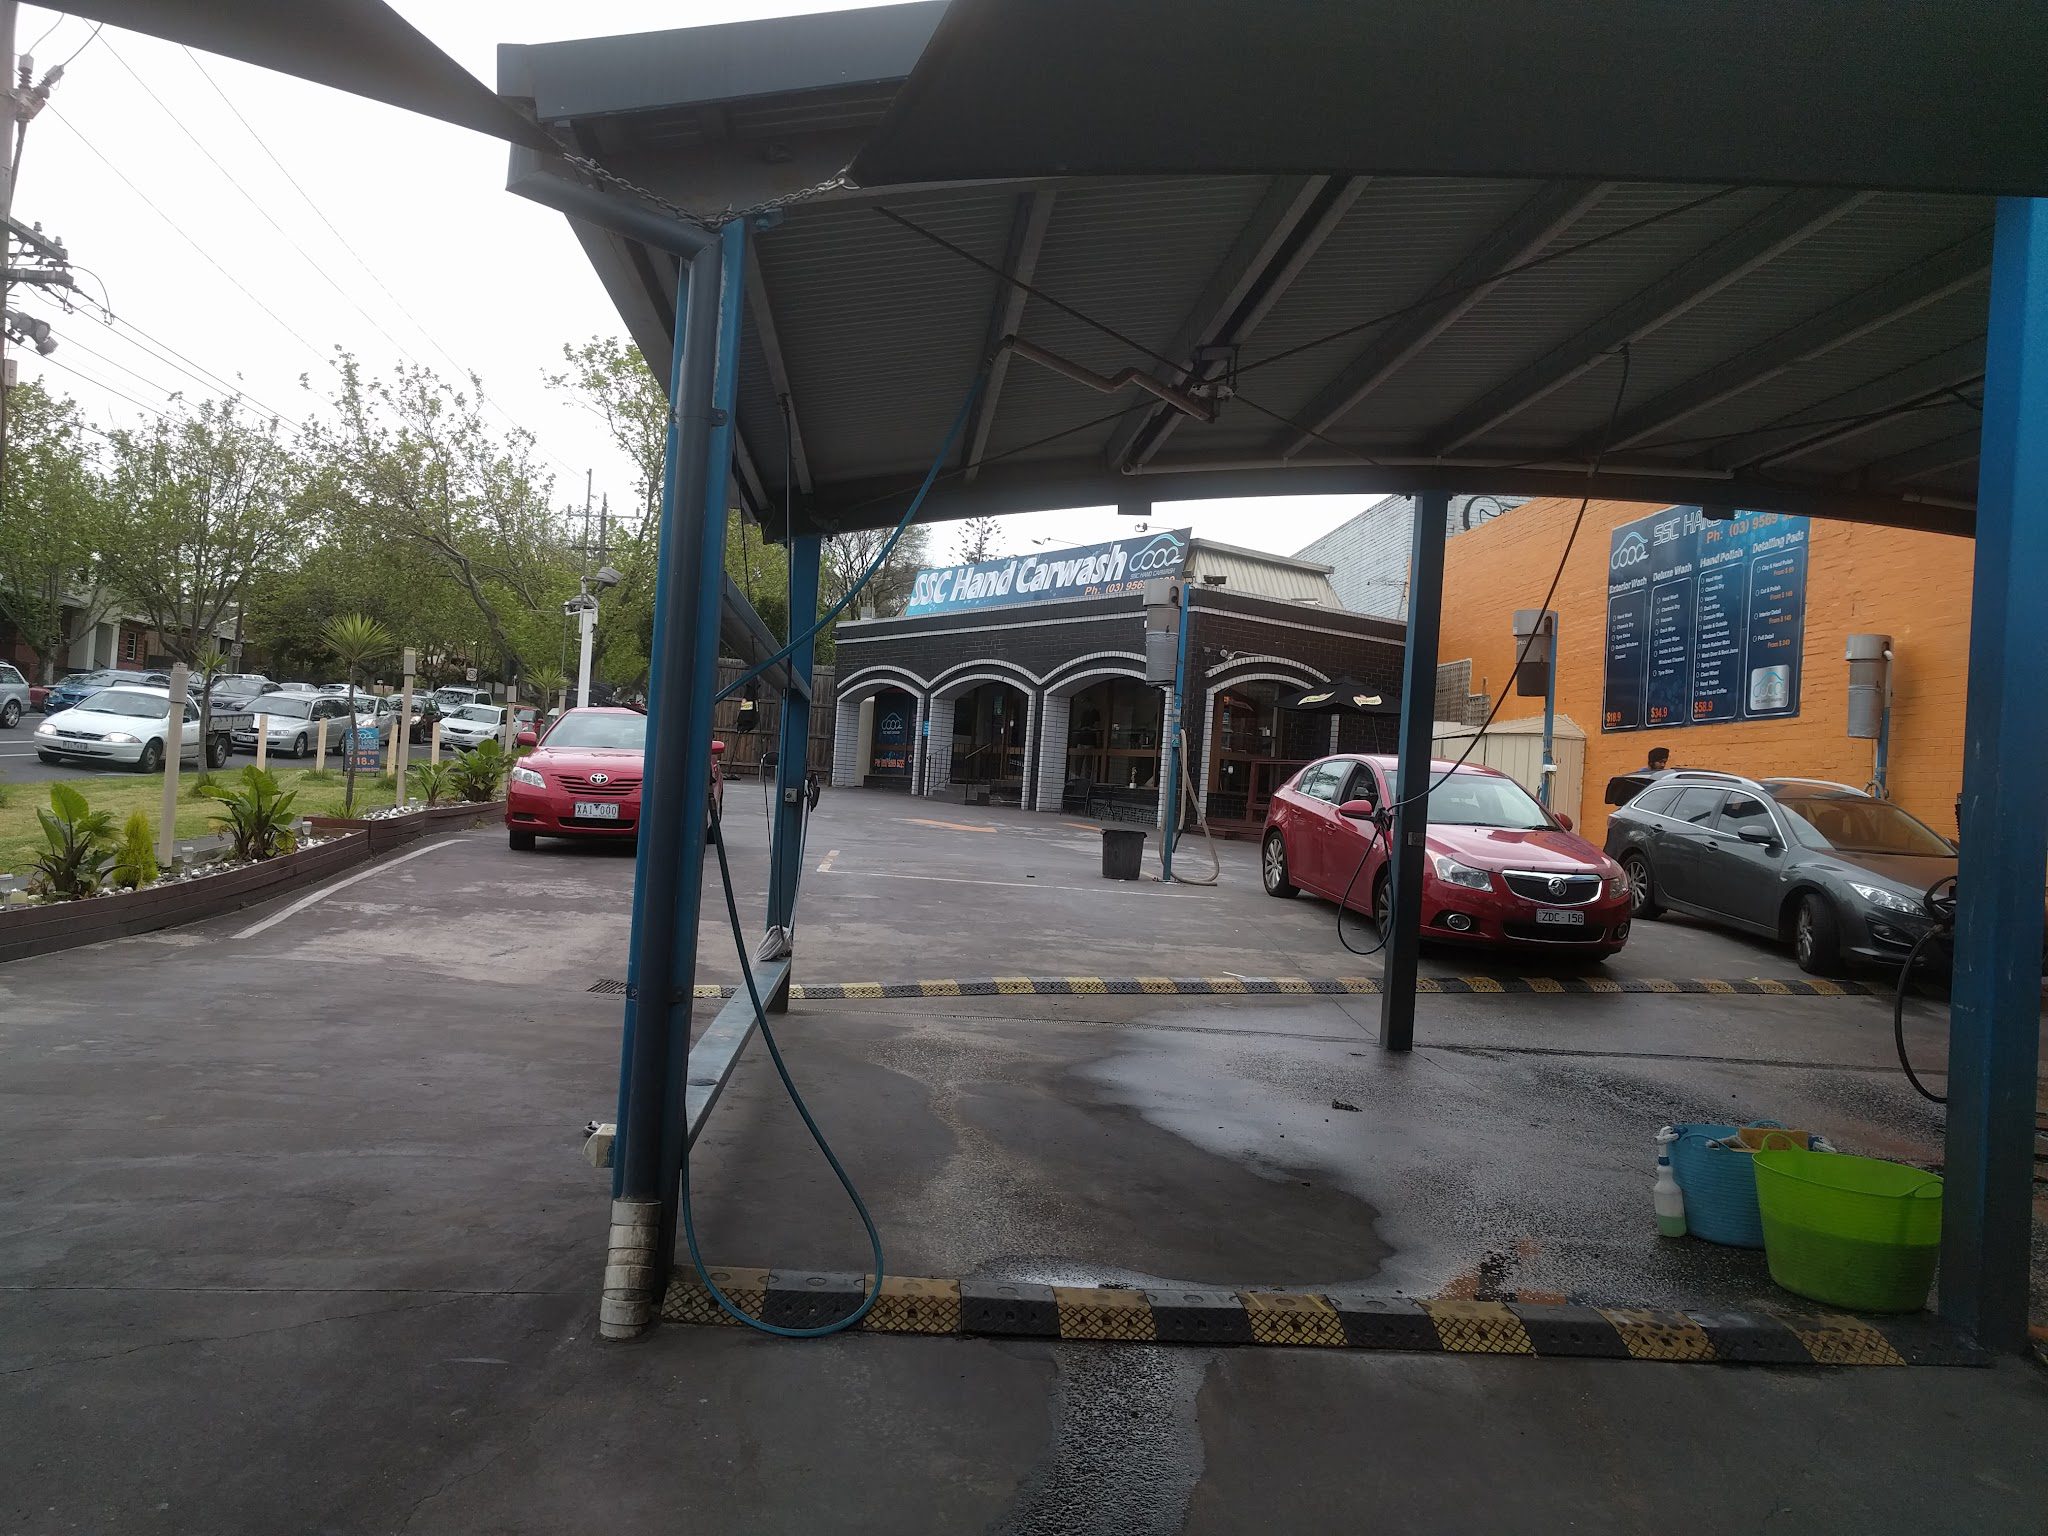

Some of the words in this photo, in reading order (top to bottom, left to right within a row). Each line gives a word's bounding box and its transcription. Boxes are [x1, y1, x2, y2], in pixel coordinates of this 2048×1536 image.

[1653, 517, 1681, 546] SSC
[1706, 530, 1724, 544] Ph:
[1729, 520, 1750, 537] (03)
[1699, 554, 1720, 568] Hand
[1720, 548, 1744, 563] Polish
[910, 571, 952, 608] SSC
[950, 560, 1018, 602] Hand
[1016, 544, 1128, 594] Carwash
[1652, 569, 1674, 582] Deluxe
[1674, 563, 1692, 575] Wash
[1084, 586, 1101, 596] Ph:
[1105, 583, 1124, 593] (03)
[1609, 581, 1631, 594] Exterior
[1631, 576, 1648, 588] Wash
[1650, 706, 1668, 718] $34.9
[1694, 700, 1712, 712] $58.9
[1607, 712, 1622, 723] $18.9
[576, 805, 592, 814] XAI
[600, 806, 617, 815] 000
